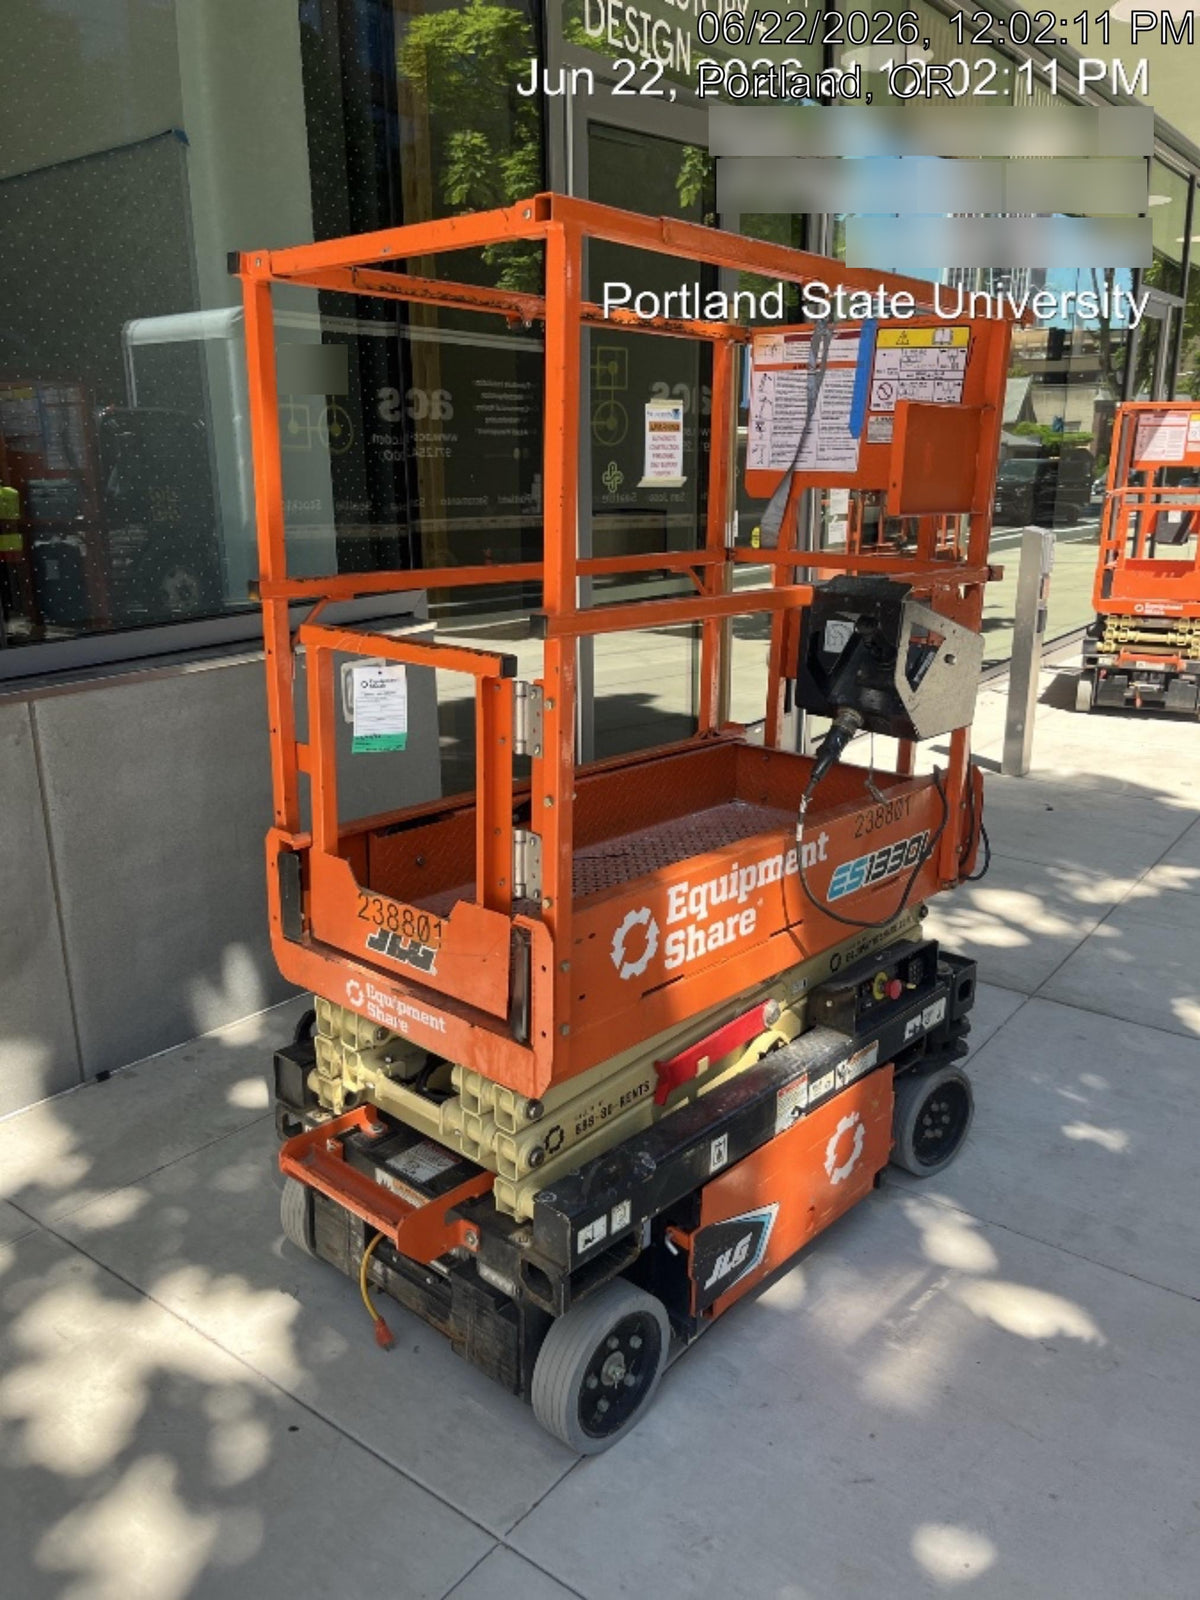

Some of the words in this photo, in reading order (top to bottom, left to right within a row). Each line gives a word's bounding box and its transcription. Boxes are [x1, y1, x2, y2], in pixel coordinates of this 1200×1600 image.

[585, 0, 691, 75] DESIGN
[854, 794, 912, 839] 238801
[666, 831, 829, 925] Equipment
[357, 892, 442, 943] 238801
[664, 907, 757, 970] Share
[365, 982, 447, 1034] Equipment
[367, 1002, 409, 1034] Share
[703, 1231, 753, 1291] JLG
